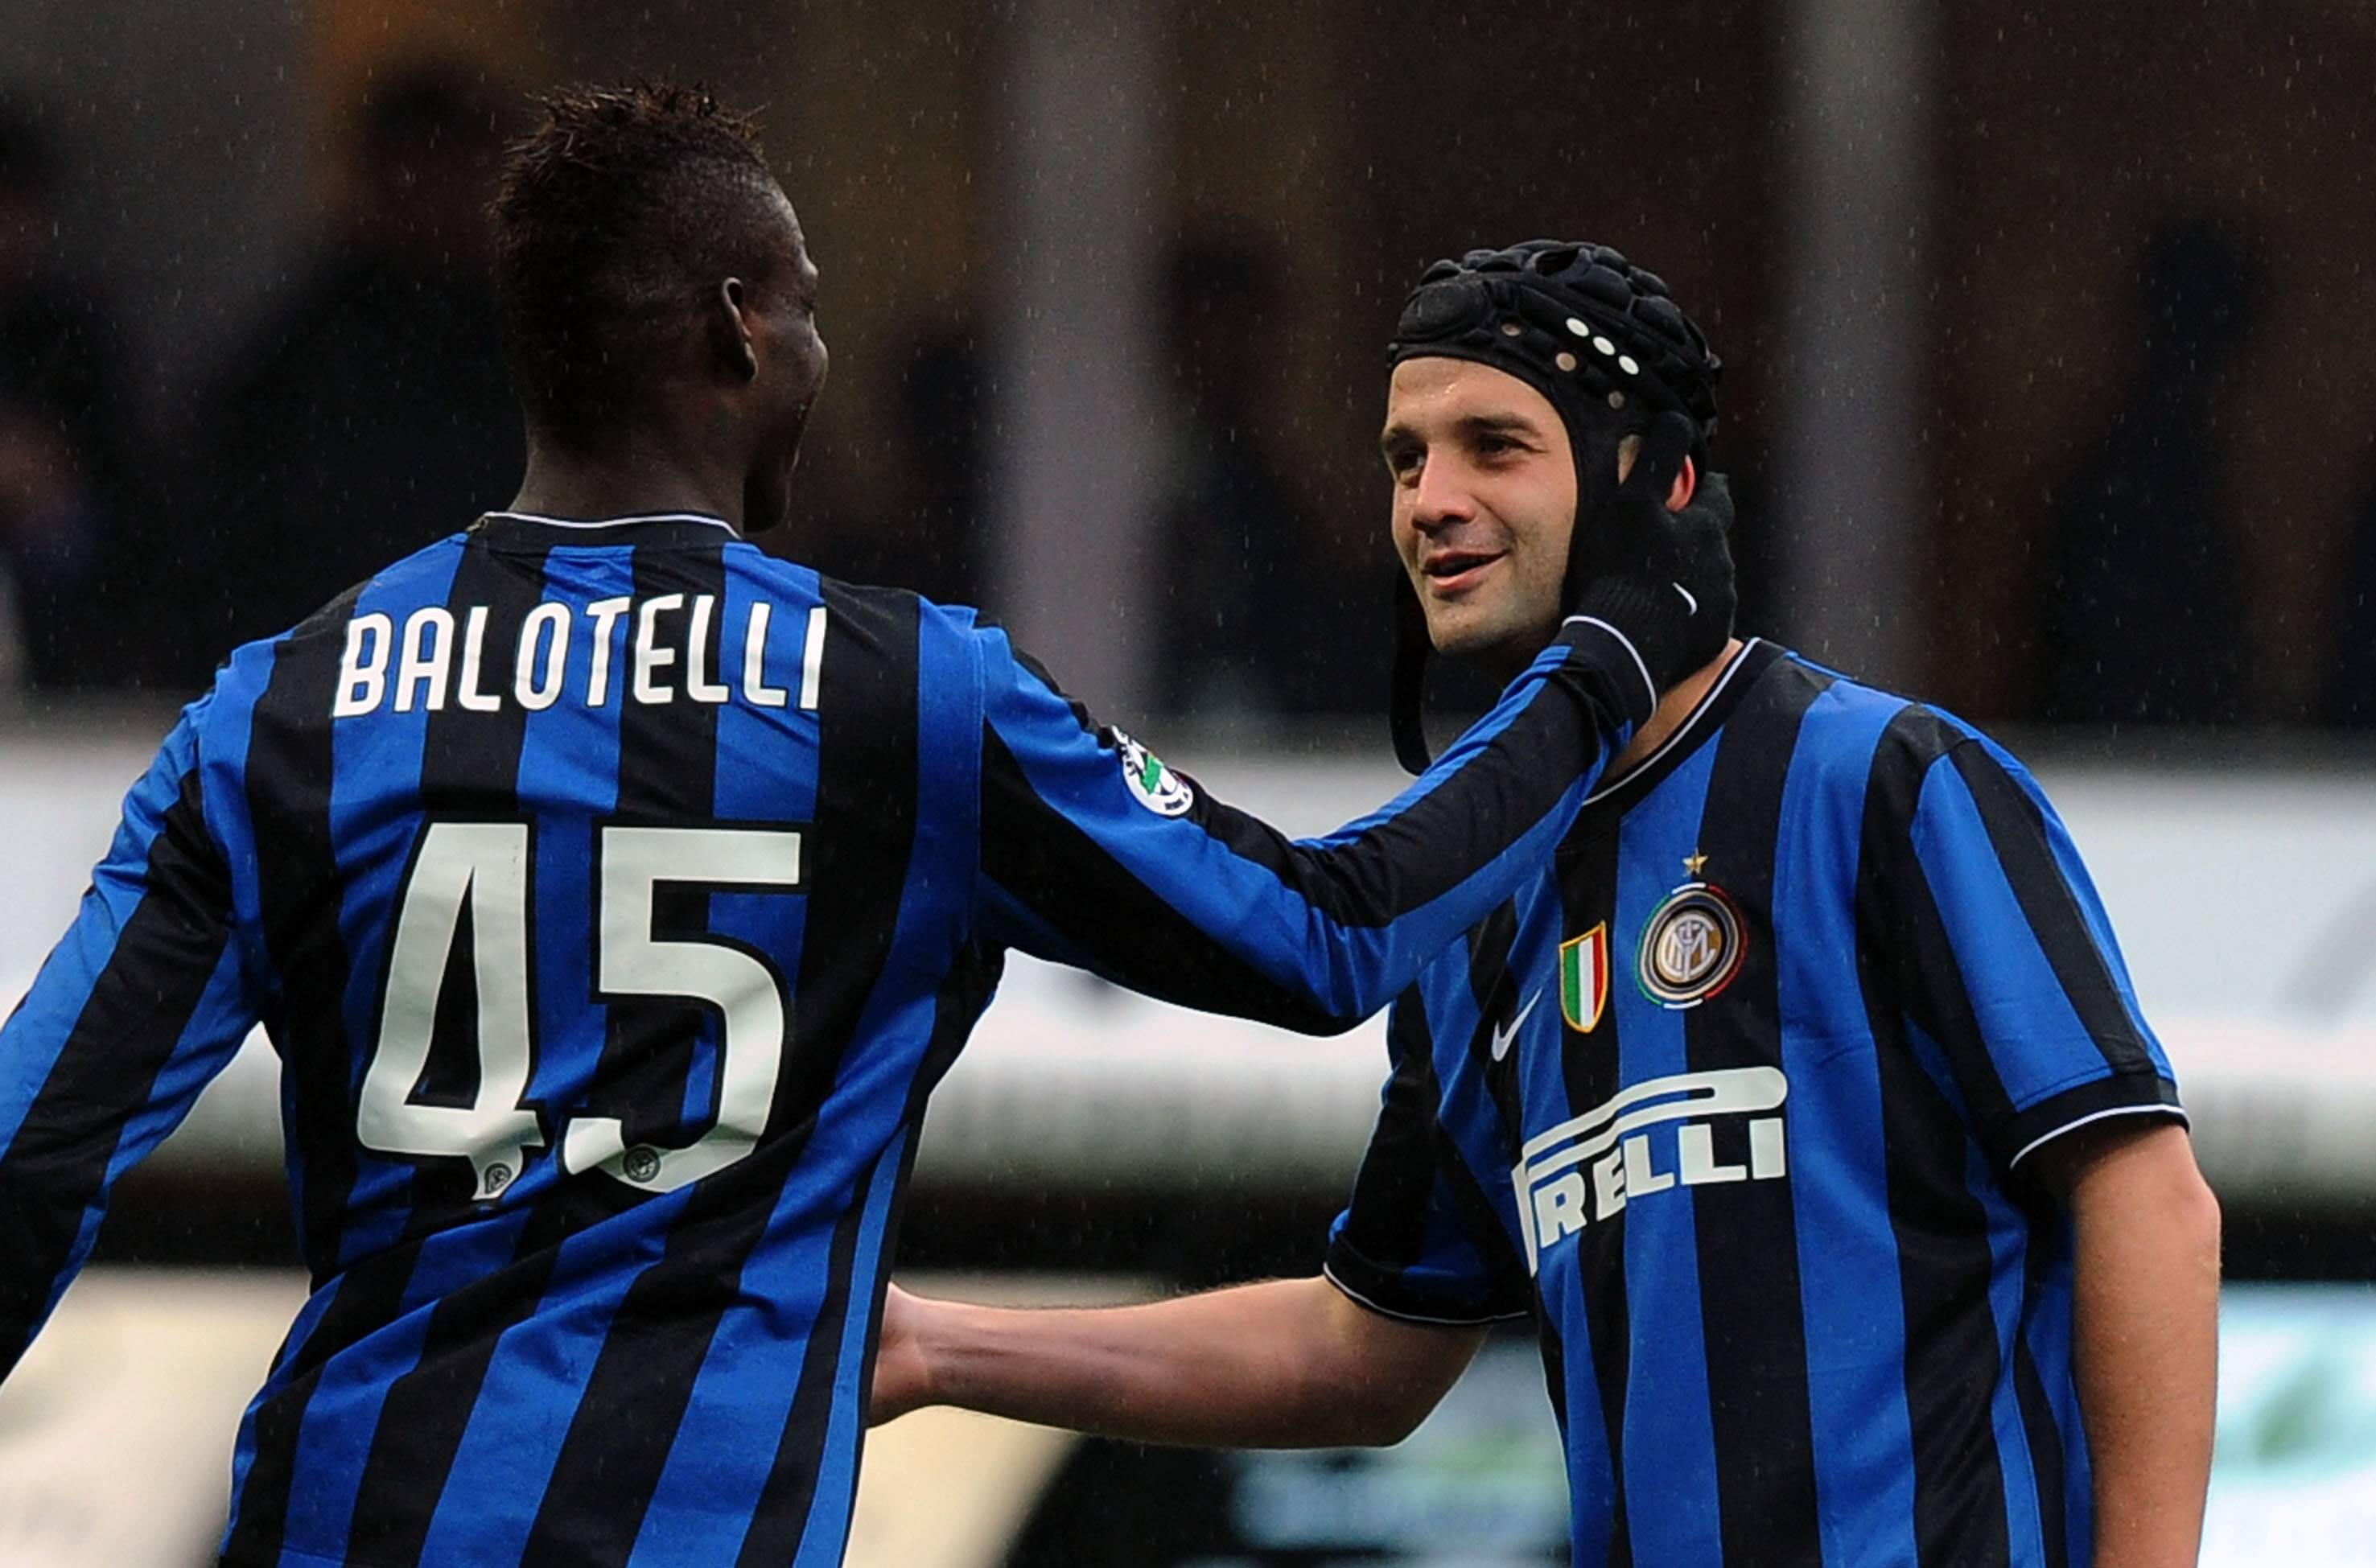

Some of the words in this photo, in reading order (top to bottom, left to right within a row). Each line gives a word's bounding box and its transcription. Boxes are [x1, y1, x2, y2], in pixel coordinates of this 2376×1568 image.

[331, 593, 828, 718] BALOTELLI
[356, 821, 801, 1200] 45
[1510, 1066, 1789, 1278] PRELLI
